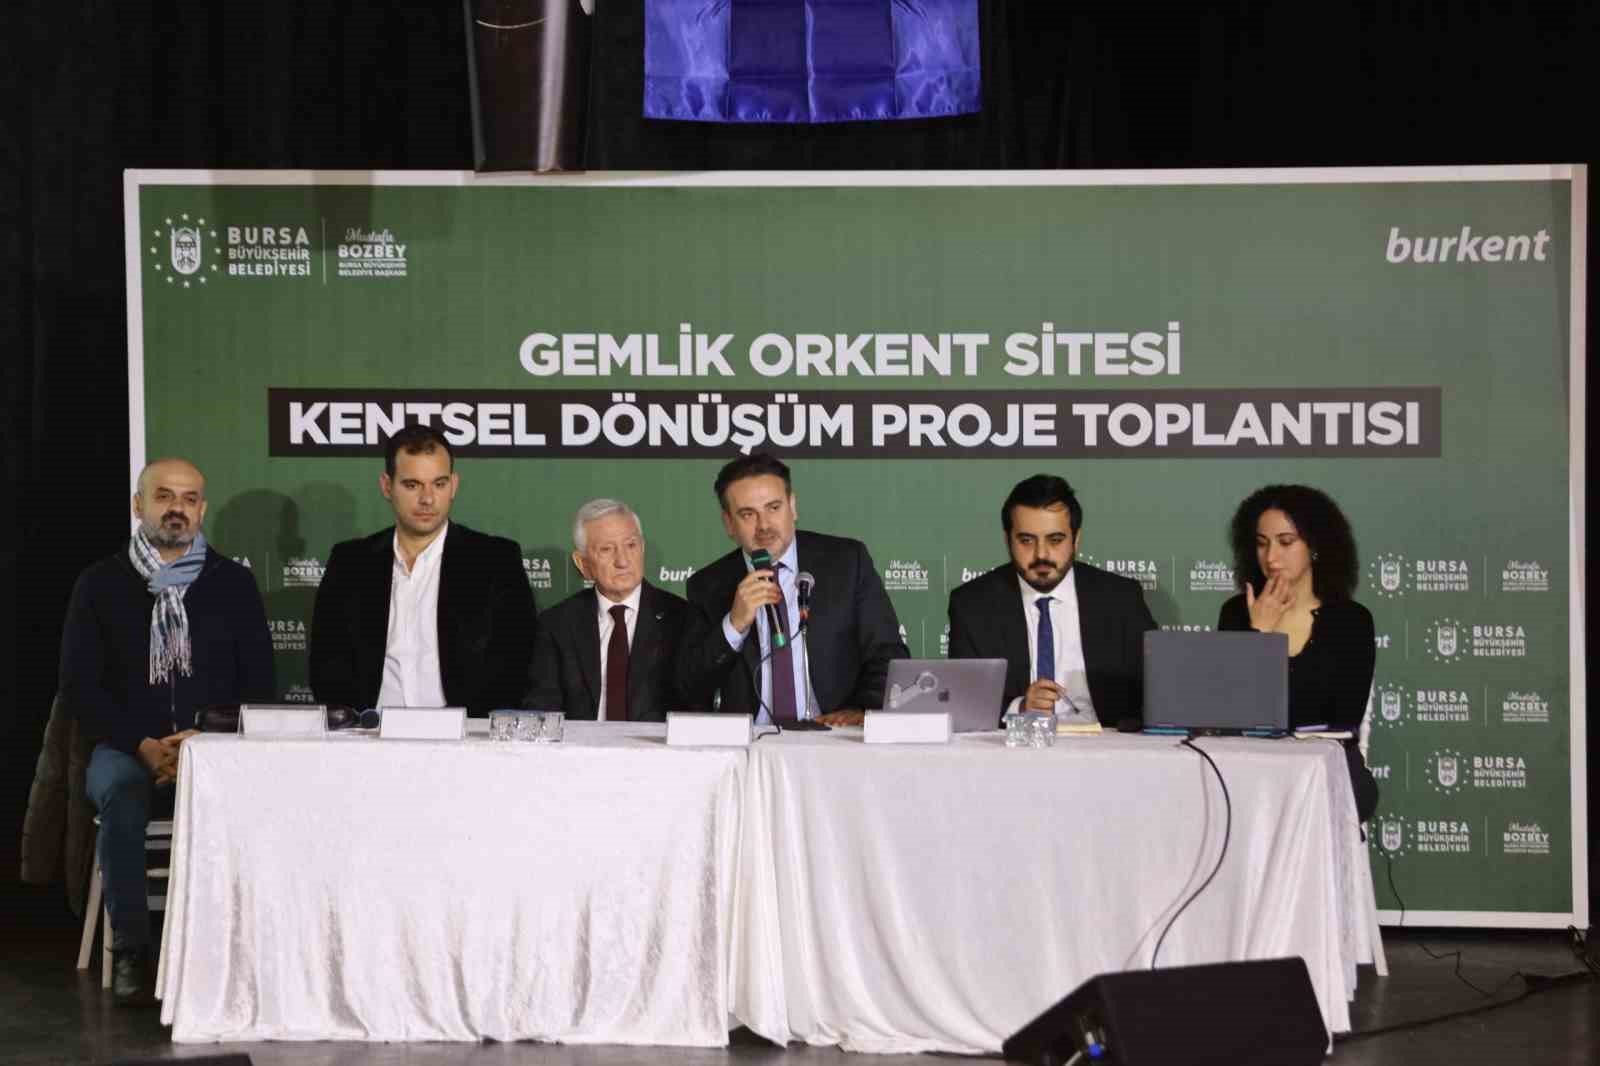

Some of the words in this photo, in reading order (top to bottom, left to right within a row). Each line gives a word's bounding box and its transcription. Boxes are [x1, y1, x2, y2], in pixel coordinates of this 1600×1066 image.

[227, 227, 310, 245] BURSA
[345, 227, 395, 244] Mustafa
[337, 244, 407, 258] BOZBEY
[1385, 226, 1550, 263] burkent
[228, 245, 310, 261] BÜYÜKŞEHİR
[228, 261, 311, 276] BELEDİYESİ
[519, 322, 735, 377] GEMLİK
[749, 332, 990, 377] ORKENT
[1004, 320, 1181, 377] SİTESİ
[289, 402, 546, 446] KENTSEL
[561, 392, 854, 456] DÖNÜŞÜM
[871, 403, 1057, 447] PROJE
[1072, 401, 1420, 447] TOPLANTISI
[522, 558, 551, 570] RSA
[1106, 560, 1157, 572] BURSA
[1416, 560, 1469, 572] BURSA
[659, 566, 696, 582] burk
[267, 620, 305, 632] URSA
[1473, 626, 1526, 637] BURSA
[1416, 691, 1469, 703] BURSA
[1473, 756, 1526, 768] BURSA
[1417, 821, 1470, 833] BURSA
